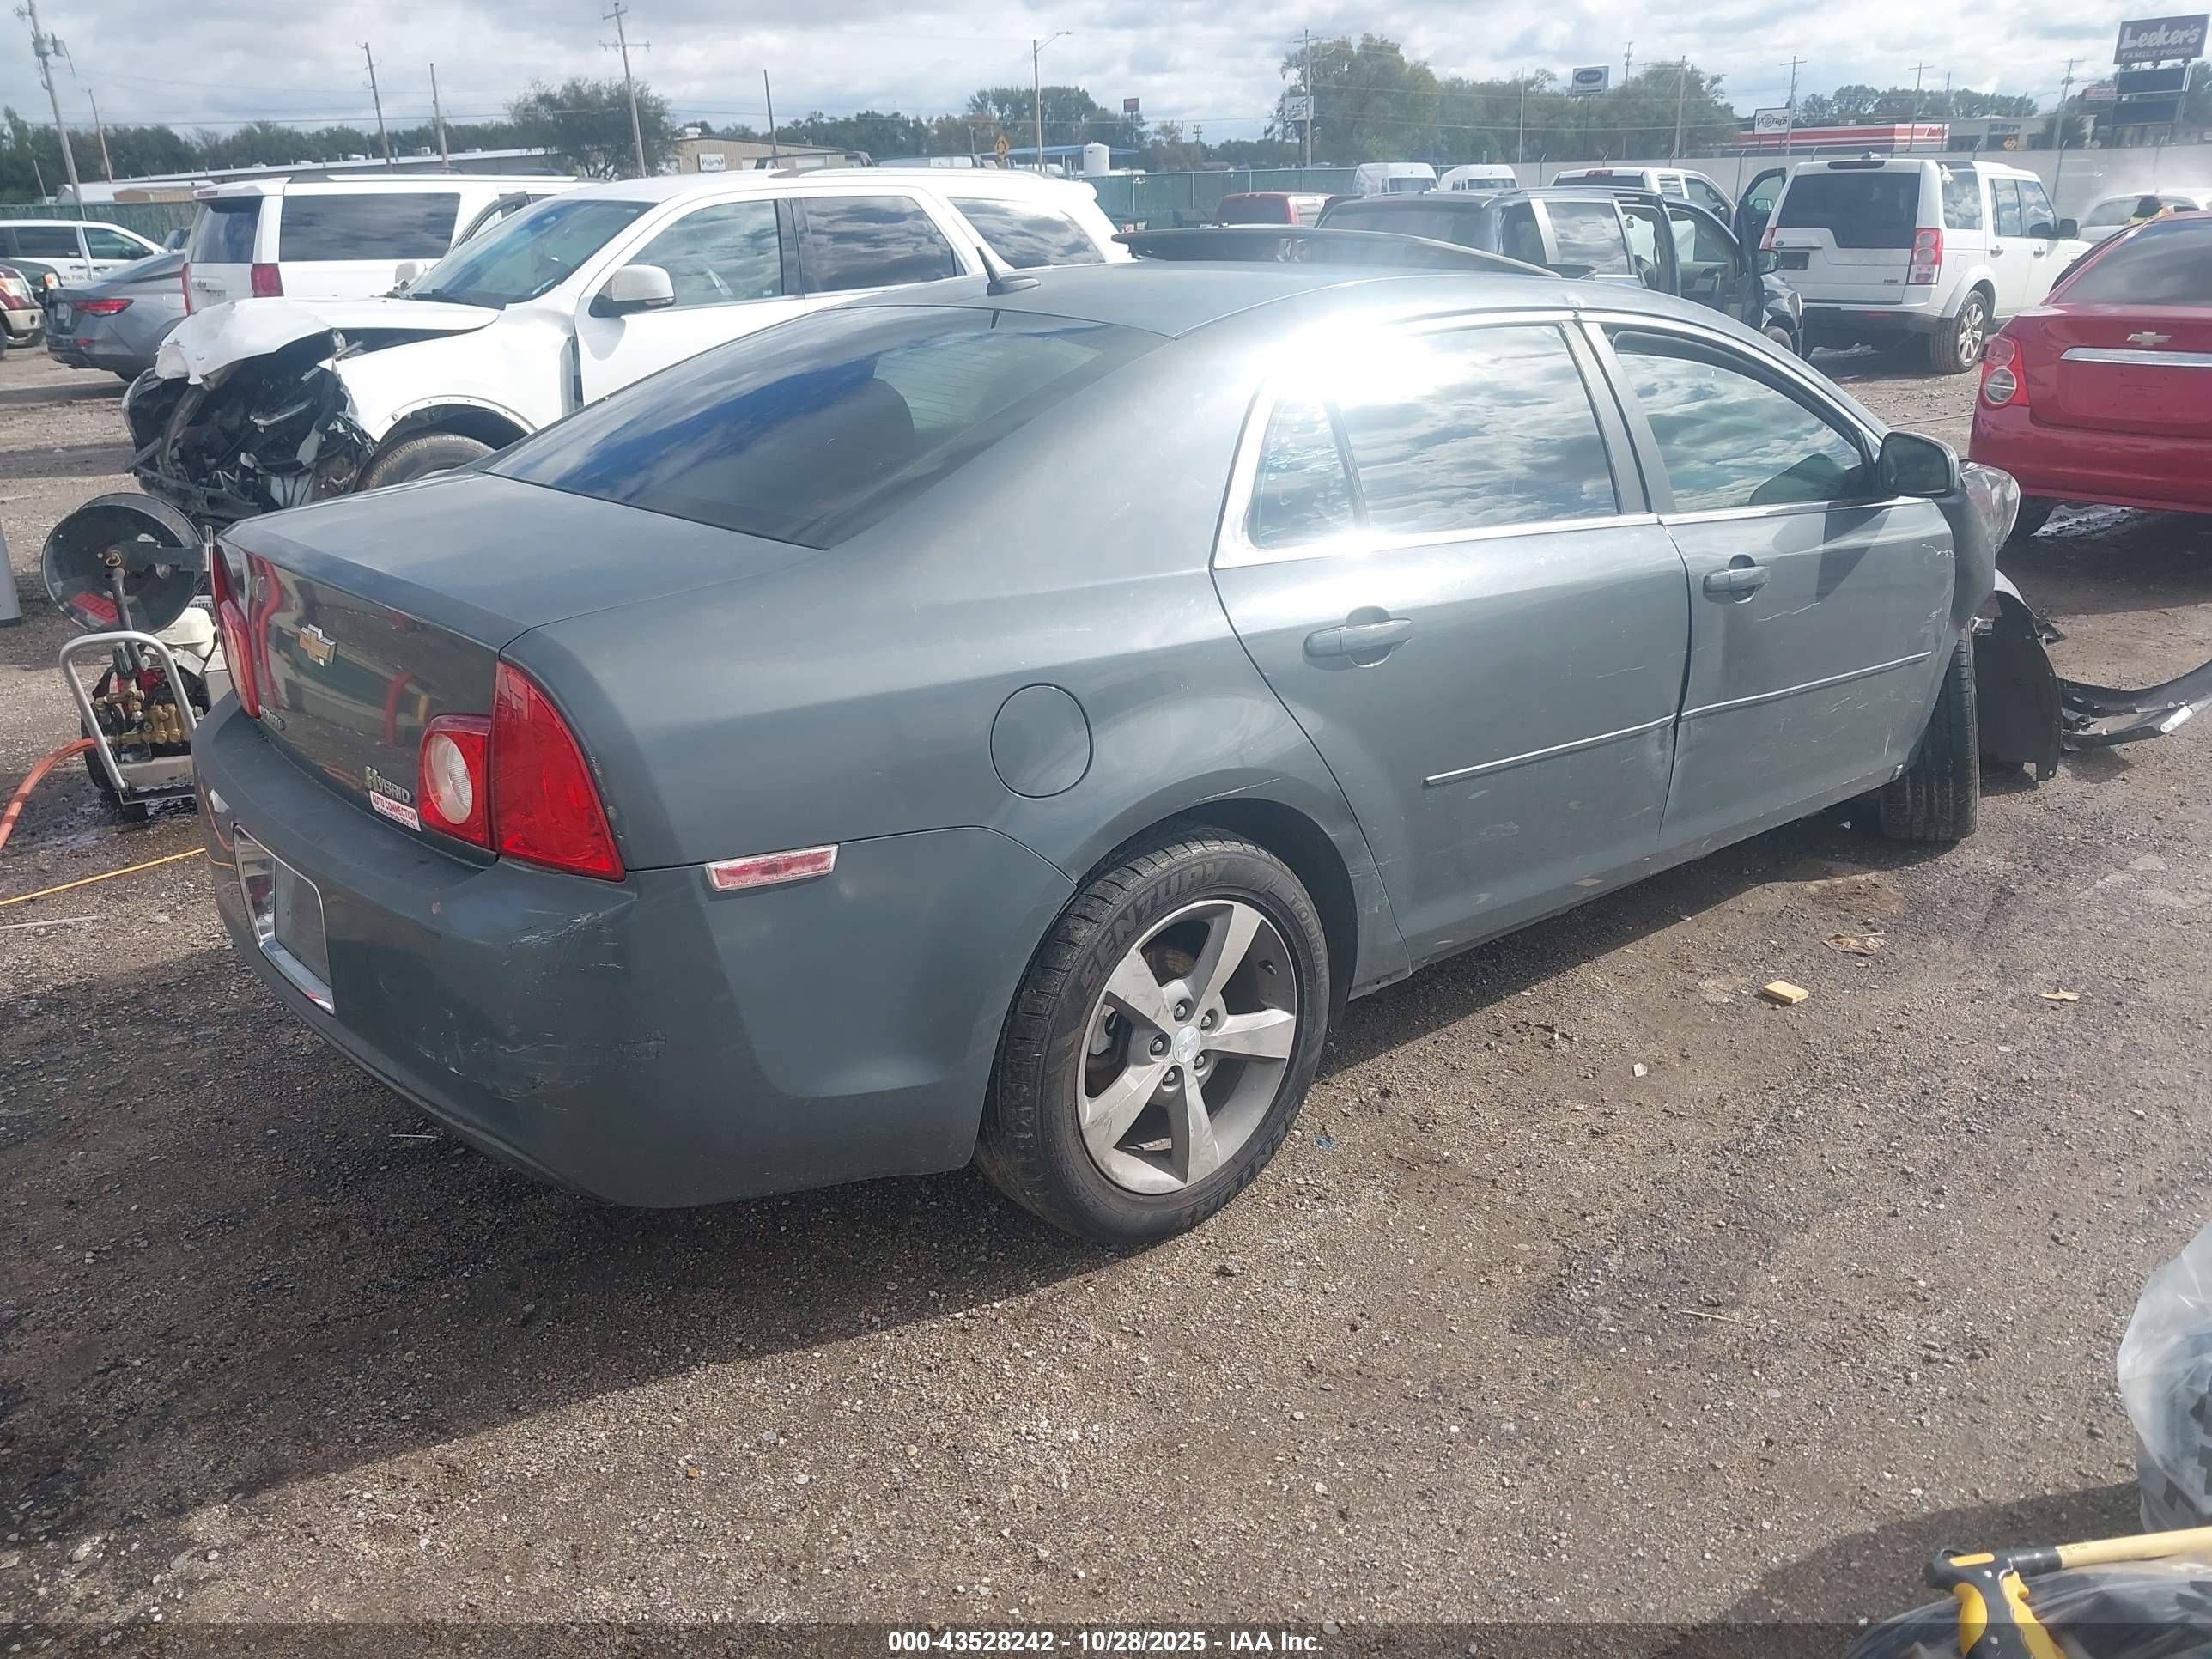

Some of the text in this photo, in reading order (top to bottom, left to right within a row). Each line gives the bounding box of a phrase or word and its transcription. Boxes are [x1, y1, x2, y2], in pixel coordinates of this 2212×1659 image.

[2119, 24, 2202, 49] Leeker's
[2122, 50, 2158, 59] FAMILY
[365, 765, 410, 804] HYBRID
[372, 793, 385, 808] AUTO
[385, 799, 417, 823] CONNECTION
